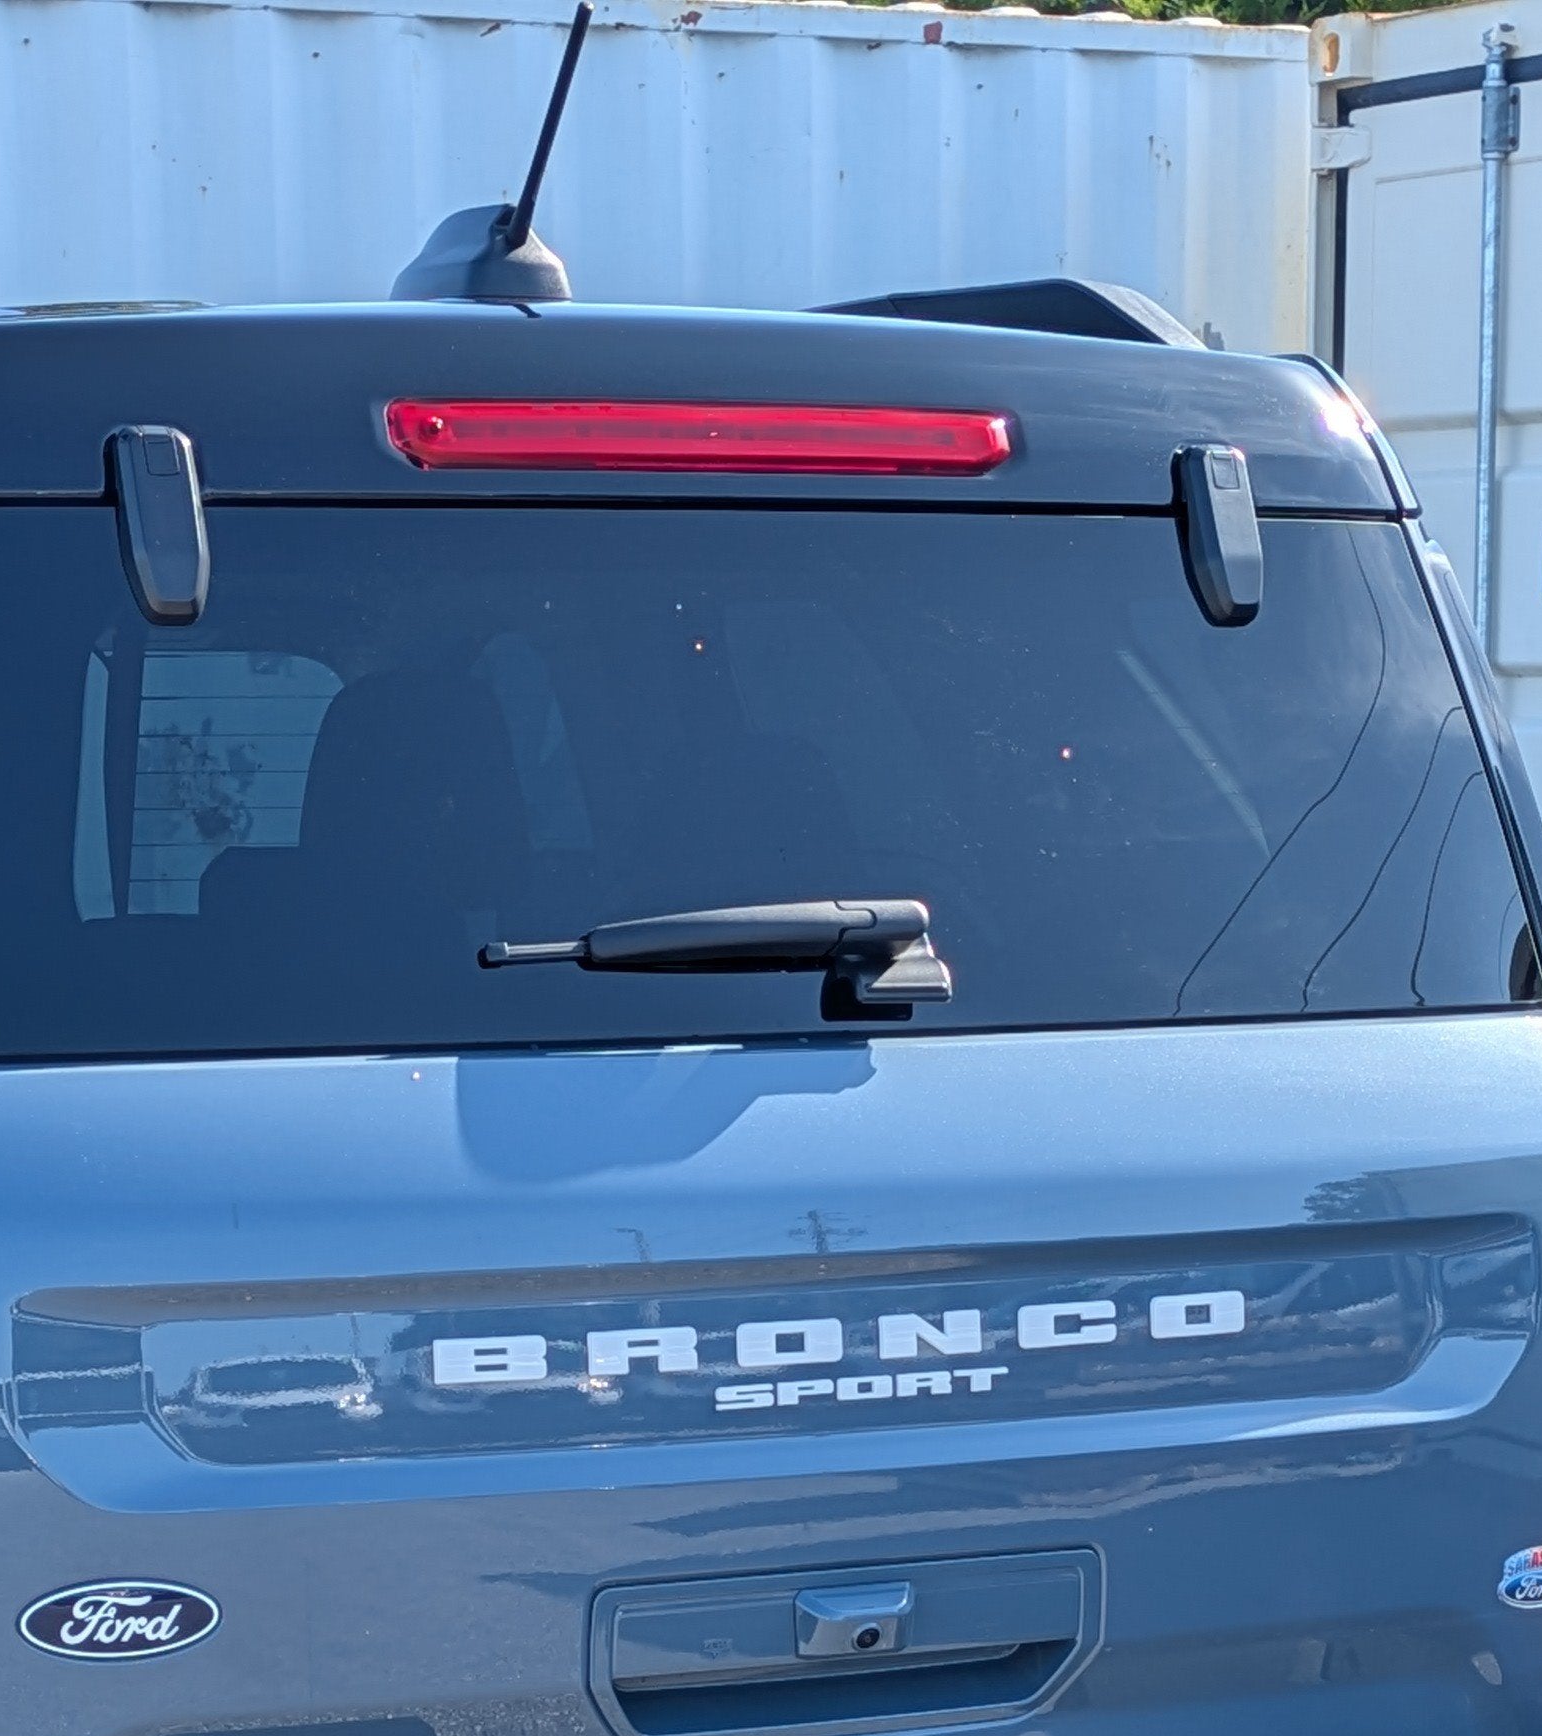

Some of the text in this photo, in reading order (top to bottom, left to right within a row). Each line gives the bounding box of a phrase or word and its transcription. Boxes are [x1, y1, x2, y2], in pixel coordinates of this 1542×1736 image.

[432, 1290, 1246, 1386] BRONCO
[714, 1365, 1010, 1412] SPORT
[59, 1594, 183, 1647] Ford
